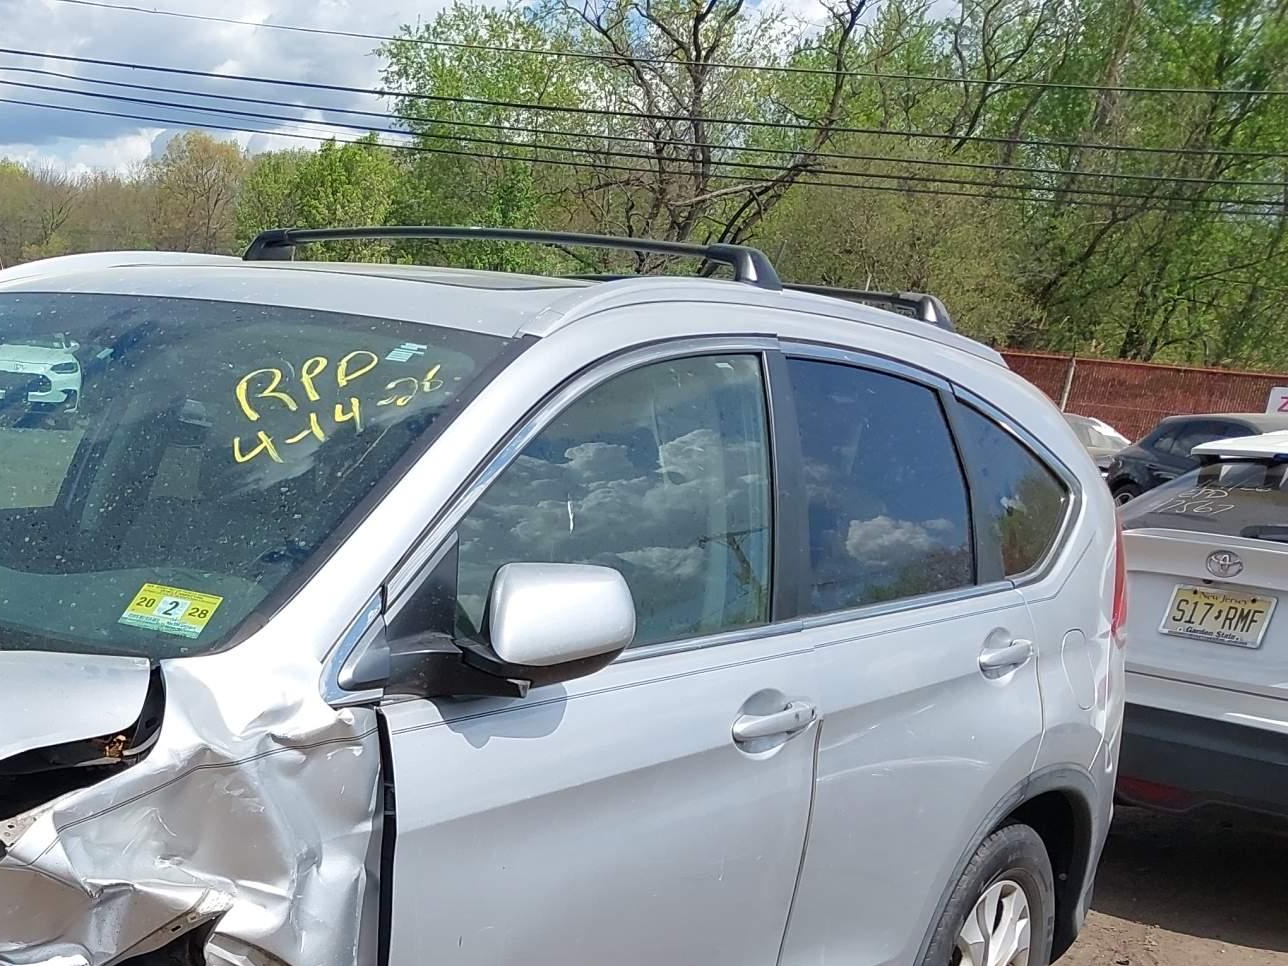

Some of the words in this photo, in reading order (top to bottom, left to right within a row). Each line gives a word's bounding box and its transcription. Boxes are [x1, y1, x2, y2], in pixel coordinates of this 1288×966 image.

[235, 350, 379, 421] RPD
[136, 596, 157, 608] 20
[162, 600, 180, 617] 2
[188, 606, 209, 619] 28
[1199, 591, 1218, 602] New
[1220, 596, 1249, 606] Jersey
[1186, 626, 1213, 636] Garden
[1215, 630, 1236, 640] State
